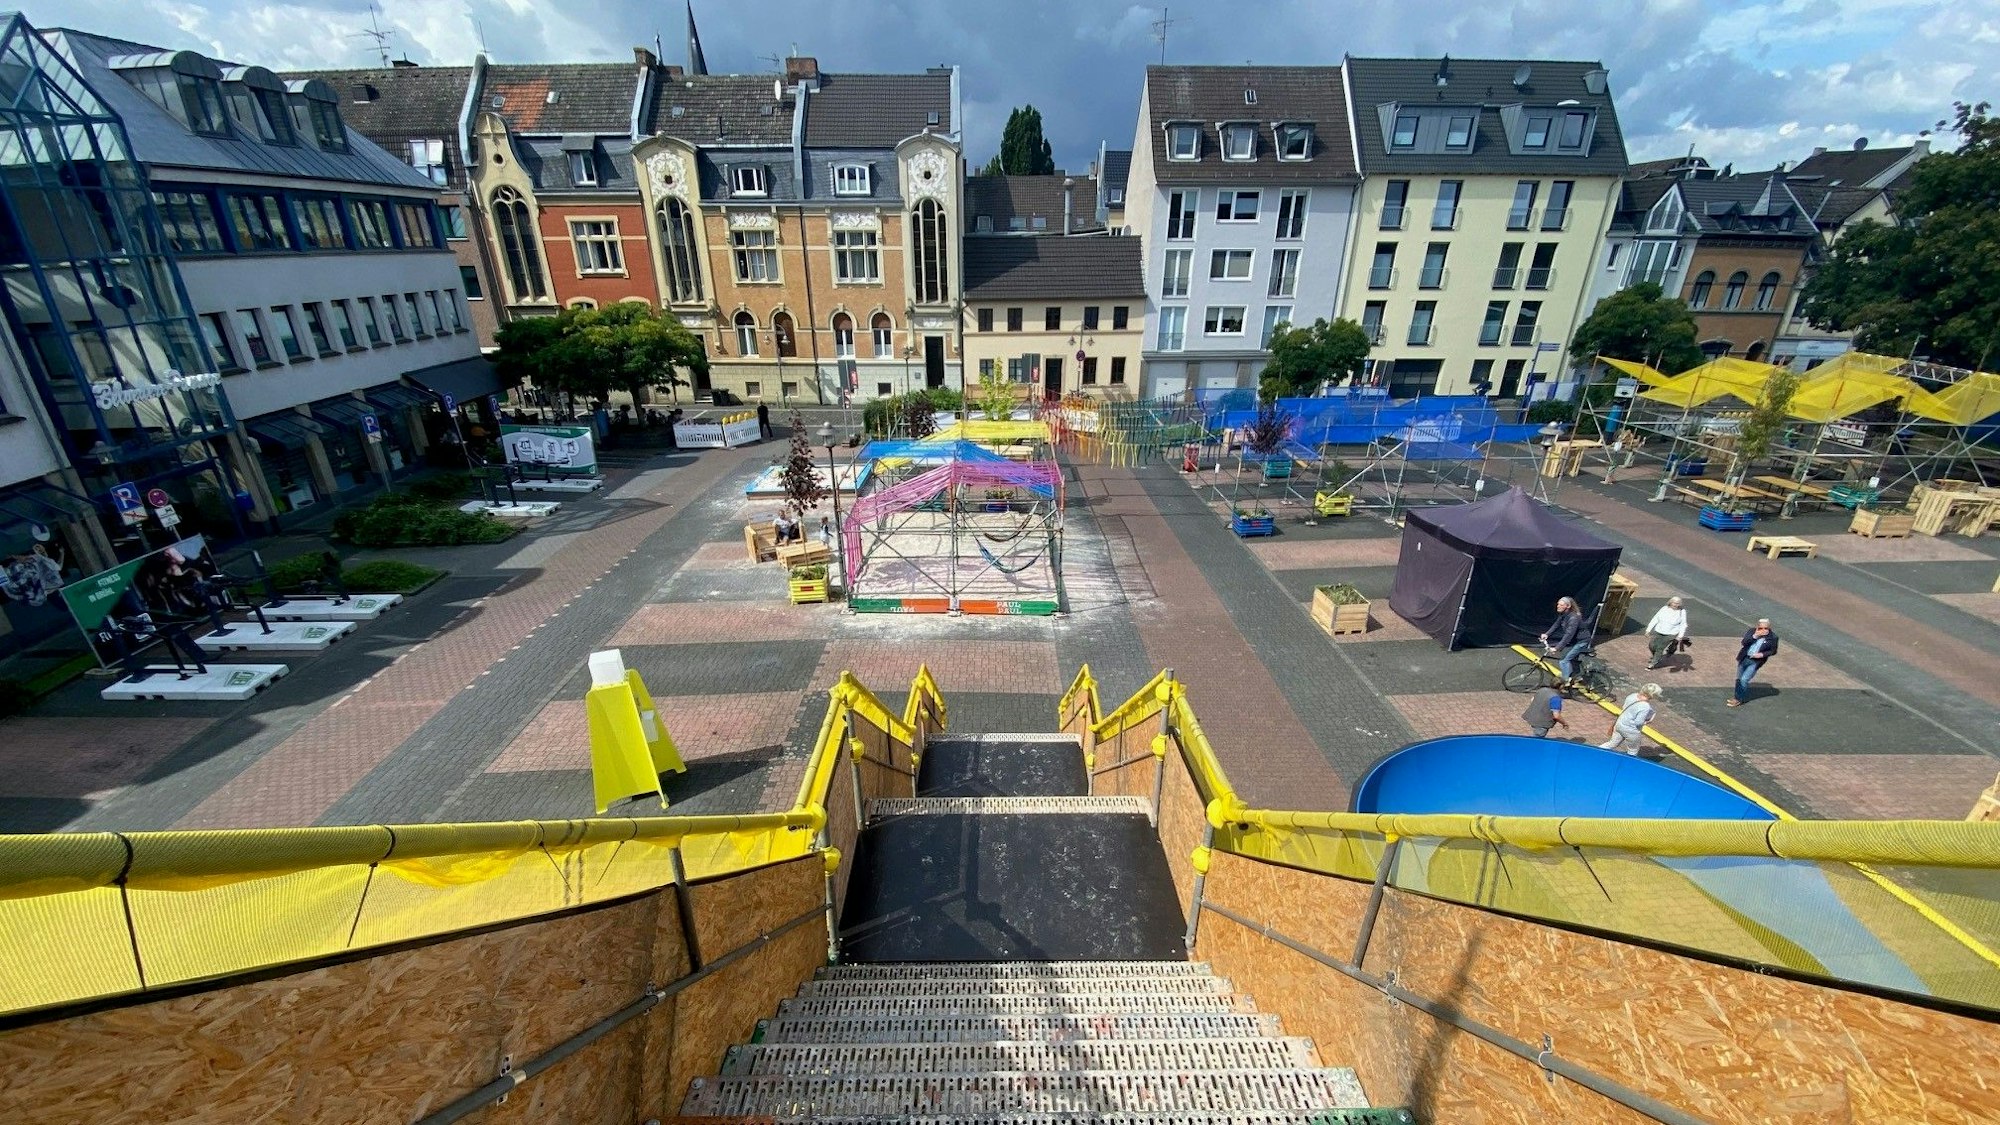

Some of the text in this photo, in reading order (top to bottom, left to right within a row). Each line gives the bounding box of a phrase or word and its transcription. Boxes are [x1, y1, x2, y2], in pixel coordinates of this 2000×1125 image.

[365, 416, 375, 432] P
[117, 488, 132, 508] P
[97, 573, 121, 587] FITNESS
